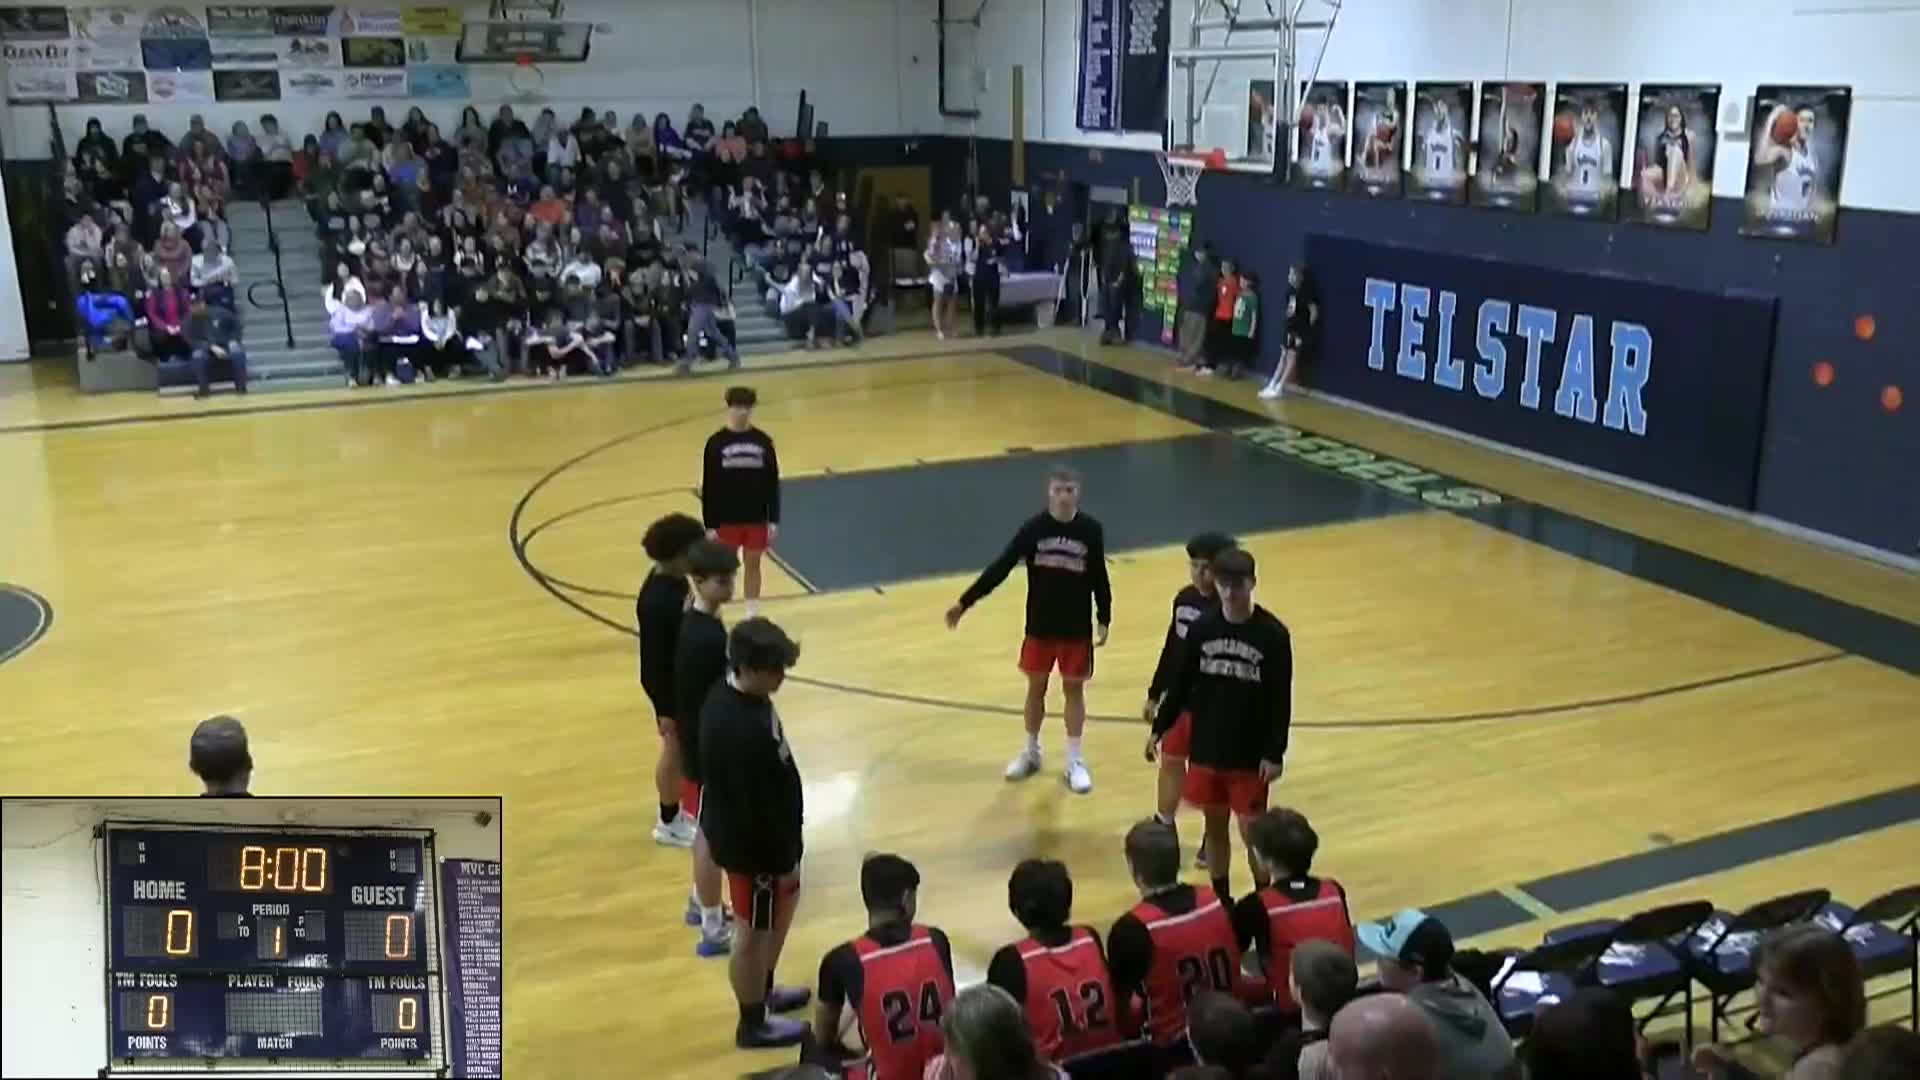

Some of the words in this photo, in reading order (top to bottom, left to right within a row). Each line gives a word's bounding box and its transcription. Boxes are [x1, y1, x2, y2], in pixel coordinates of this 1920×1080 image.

[1364, 277, 1653, 436] TELSTAR
[1233, 426, 1502, 508] REBELS
[240, 846, 327, 891] 8:00
[461, 862, 485, 875] MVC
[133, 879, 187, 900] HOME
[351, 886, 406, 905] GUEST
[237, 914, 244, 925] P
[252, 904, 290, 916] PERIOD
[166, 909, 192, 955] 0
[238, 926, 250, 937] TO
[274, 926, 281, 955] 1
[293, 927, 305, 937] TO
[385, 914, 410, 957] 0
[116, 972, 135, 987] TM
[140, 973, 178, 988] FOULS
[228, 974, 274, 988] PLAYER
[287, 976, 324, 989] FOULS
[368, 976, 385, 990] TM
[390, 976, 426, 990] FOULS
[1177, 947, 1233, 1004] 20
[147, 995, 168, 1028] 0
[398, 997, 417, 1030] 0
[880, 978, 944, 1047] 24
[1048, 979, 1107, 1038] 12
[127, 1036, 167, 1049] POINTS
[257, 1037, 293, 1049] MATCH
[380, 1037, 417, 1049] POINTS
